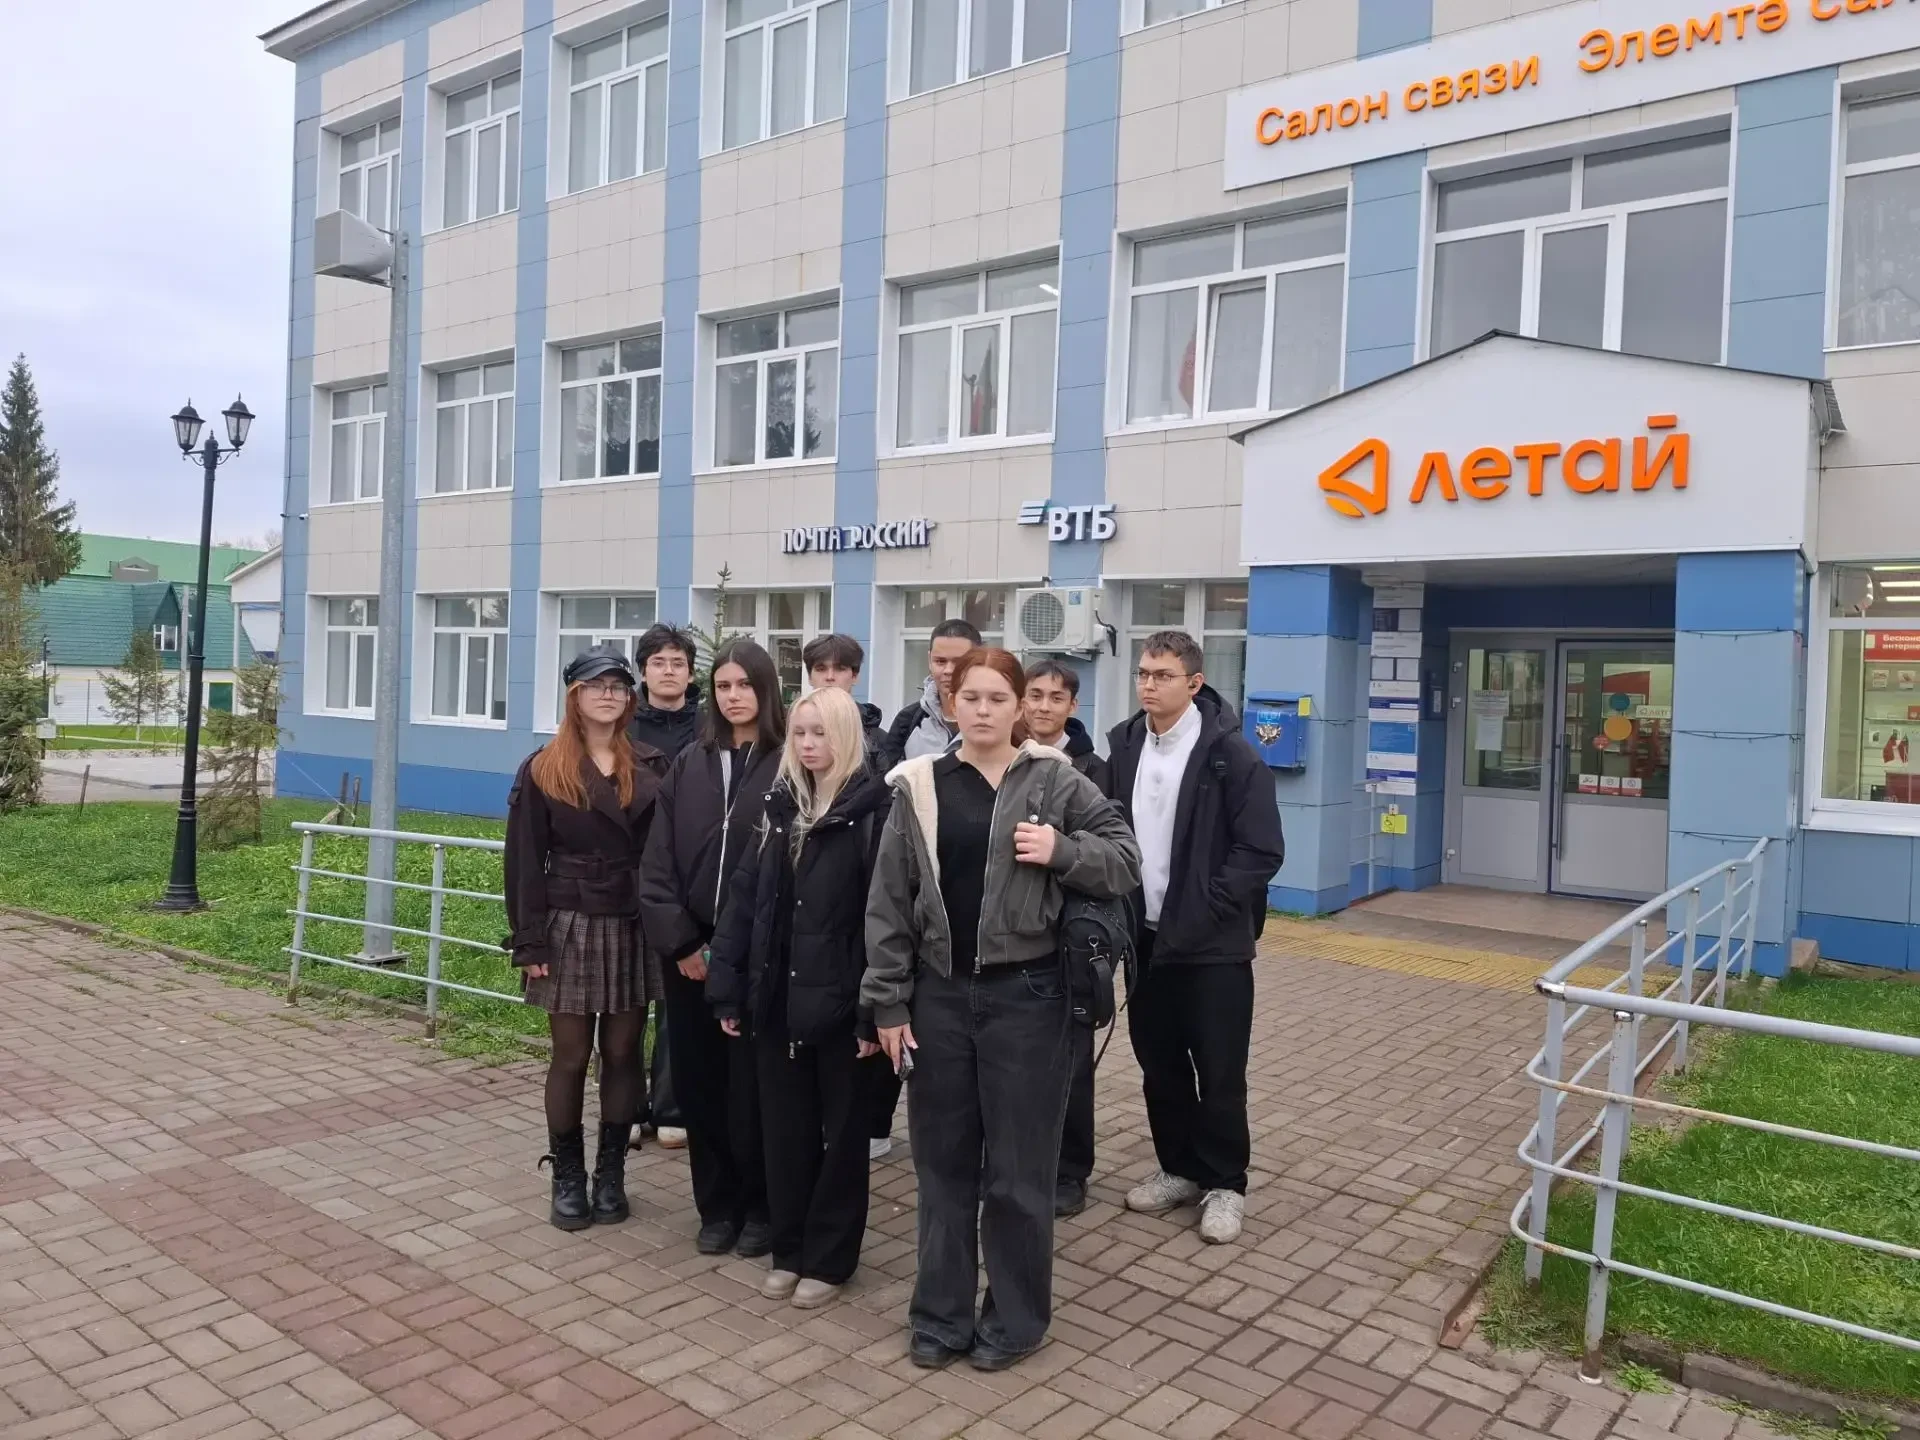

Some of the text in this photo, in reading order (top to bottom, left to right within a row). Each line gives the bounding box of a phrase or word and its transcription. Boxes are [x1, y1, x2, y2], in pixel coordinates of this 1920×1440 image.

[1257, 94, 1388, 146] Салон
[1405, 57, 1539, 114] связи
[1410, 415, 1691, 505] летай
[781, 516, 933, 553] ПОЧТА РОССИИ
[1048, 504, 1117, 542] ВТБ
